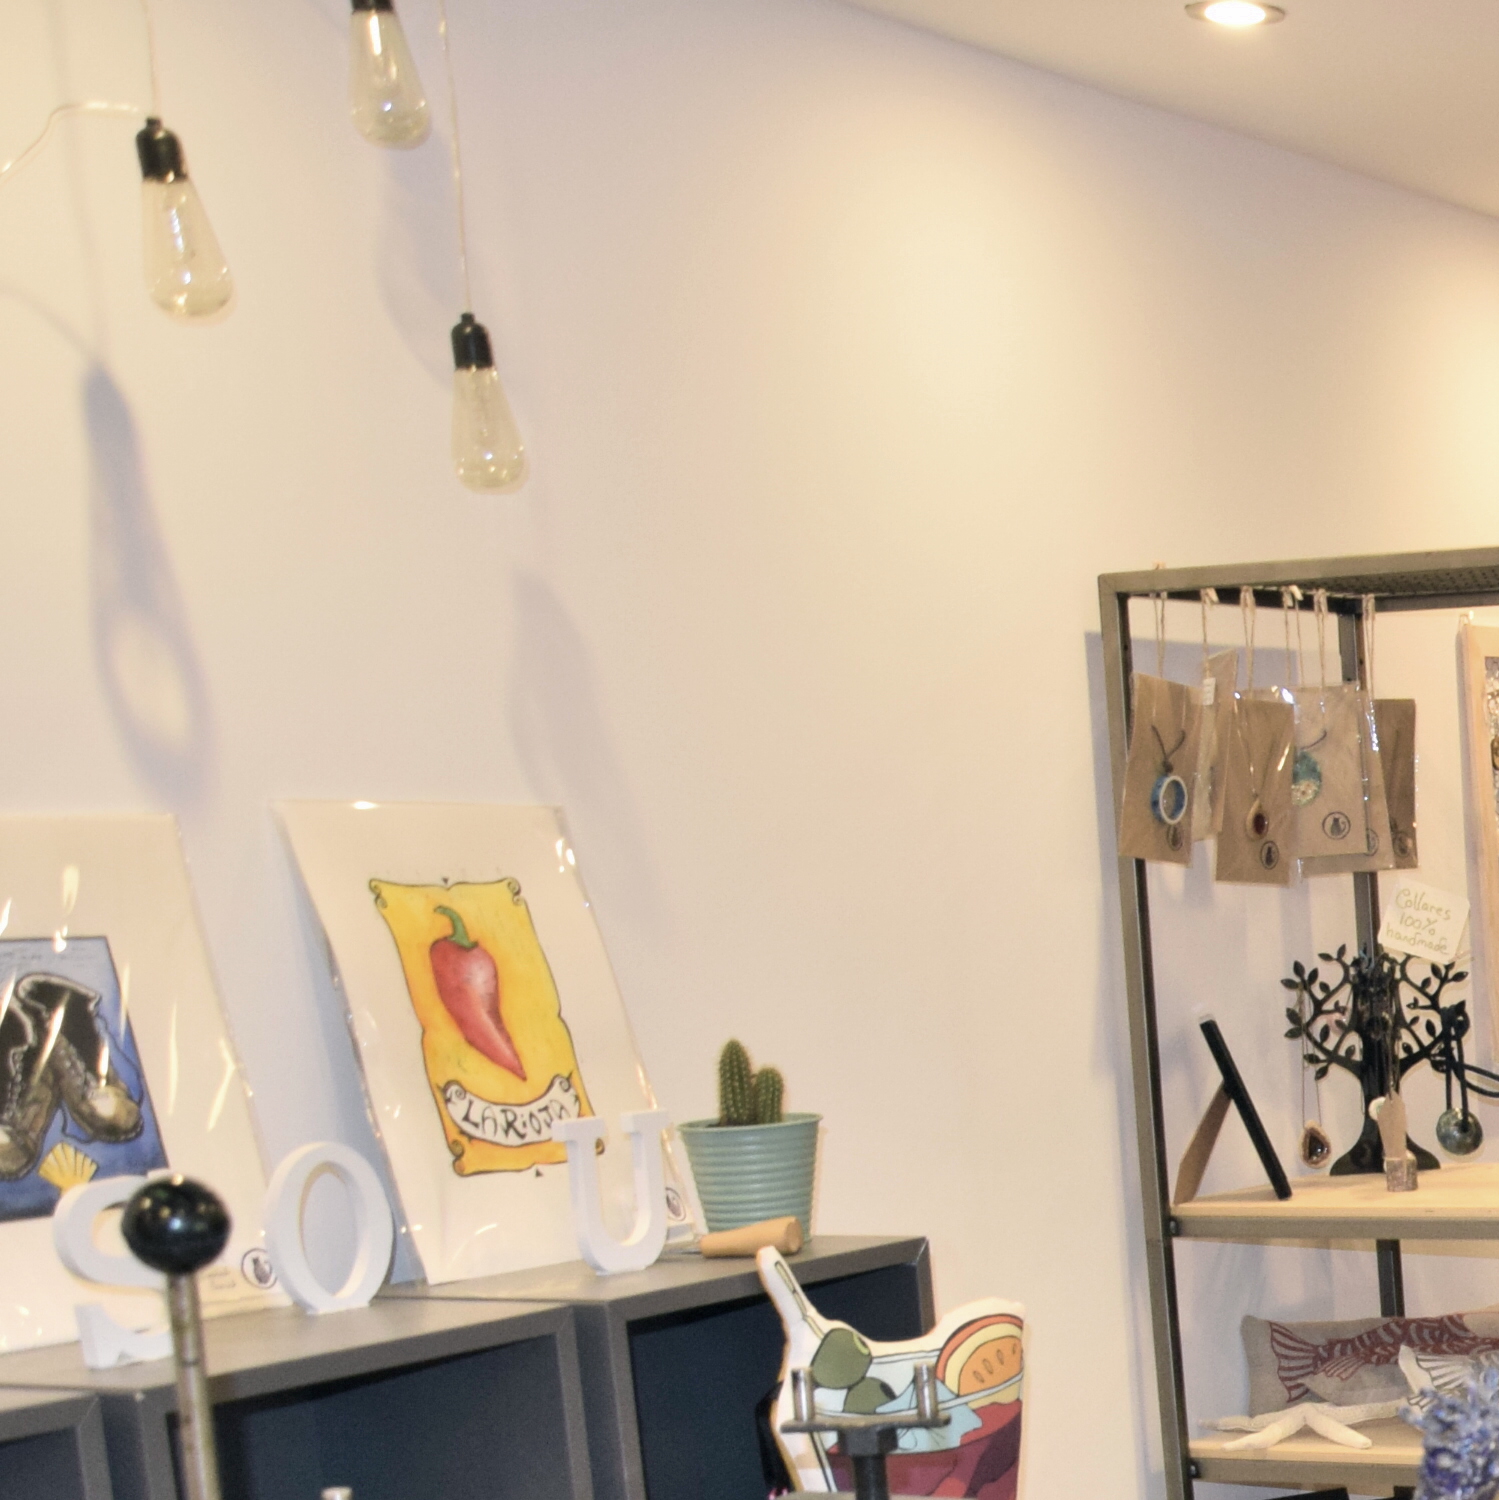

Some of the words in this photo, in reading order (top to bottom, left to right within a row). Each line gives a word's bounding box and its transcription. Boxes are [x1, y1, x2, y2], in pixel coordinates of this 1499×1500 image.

[1395, 888, 1452, 921] Collares
[1385, 922, 1450, 955] handmade
[1399, 912, 1438, 936] 100%
[462, 1099, 498, 1137] LA
